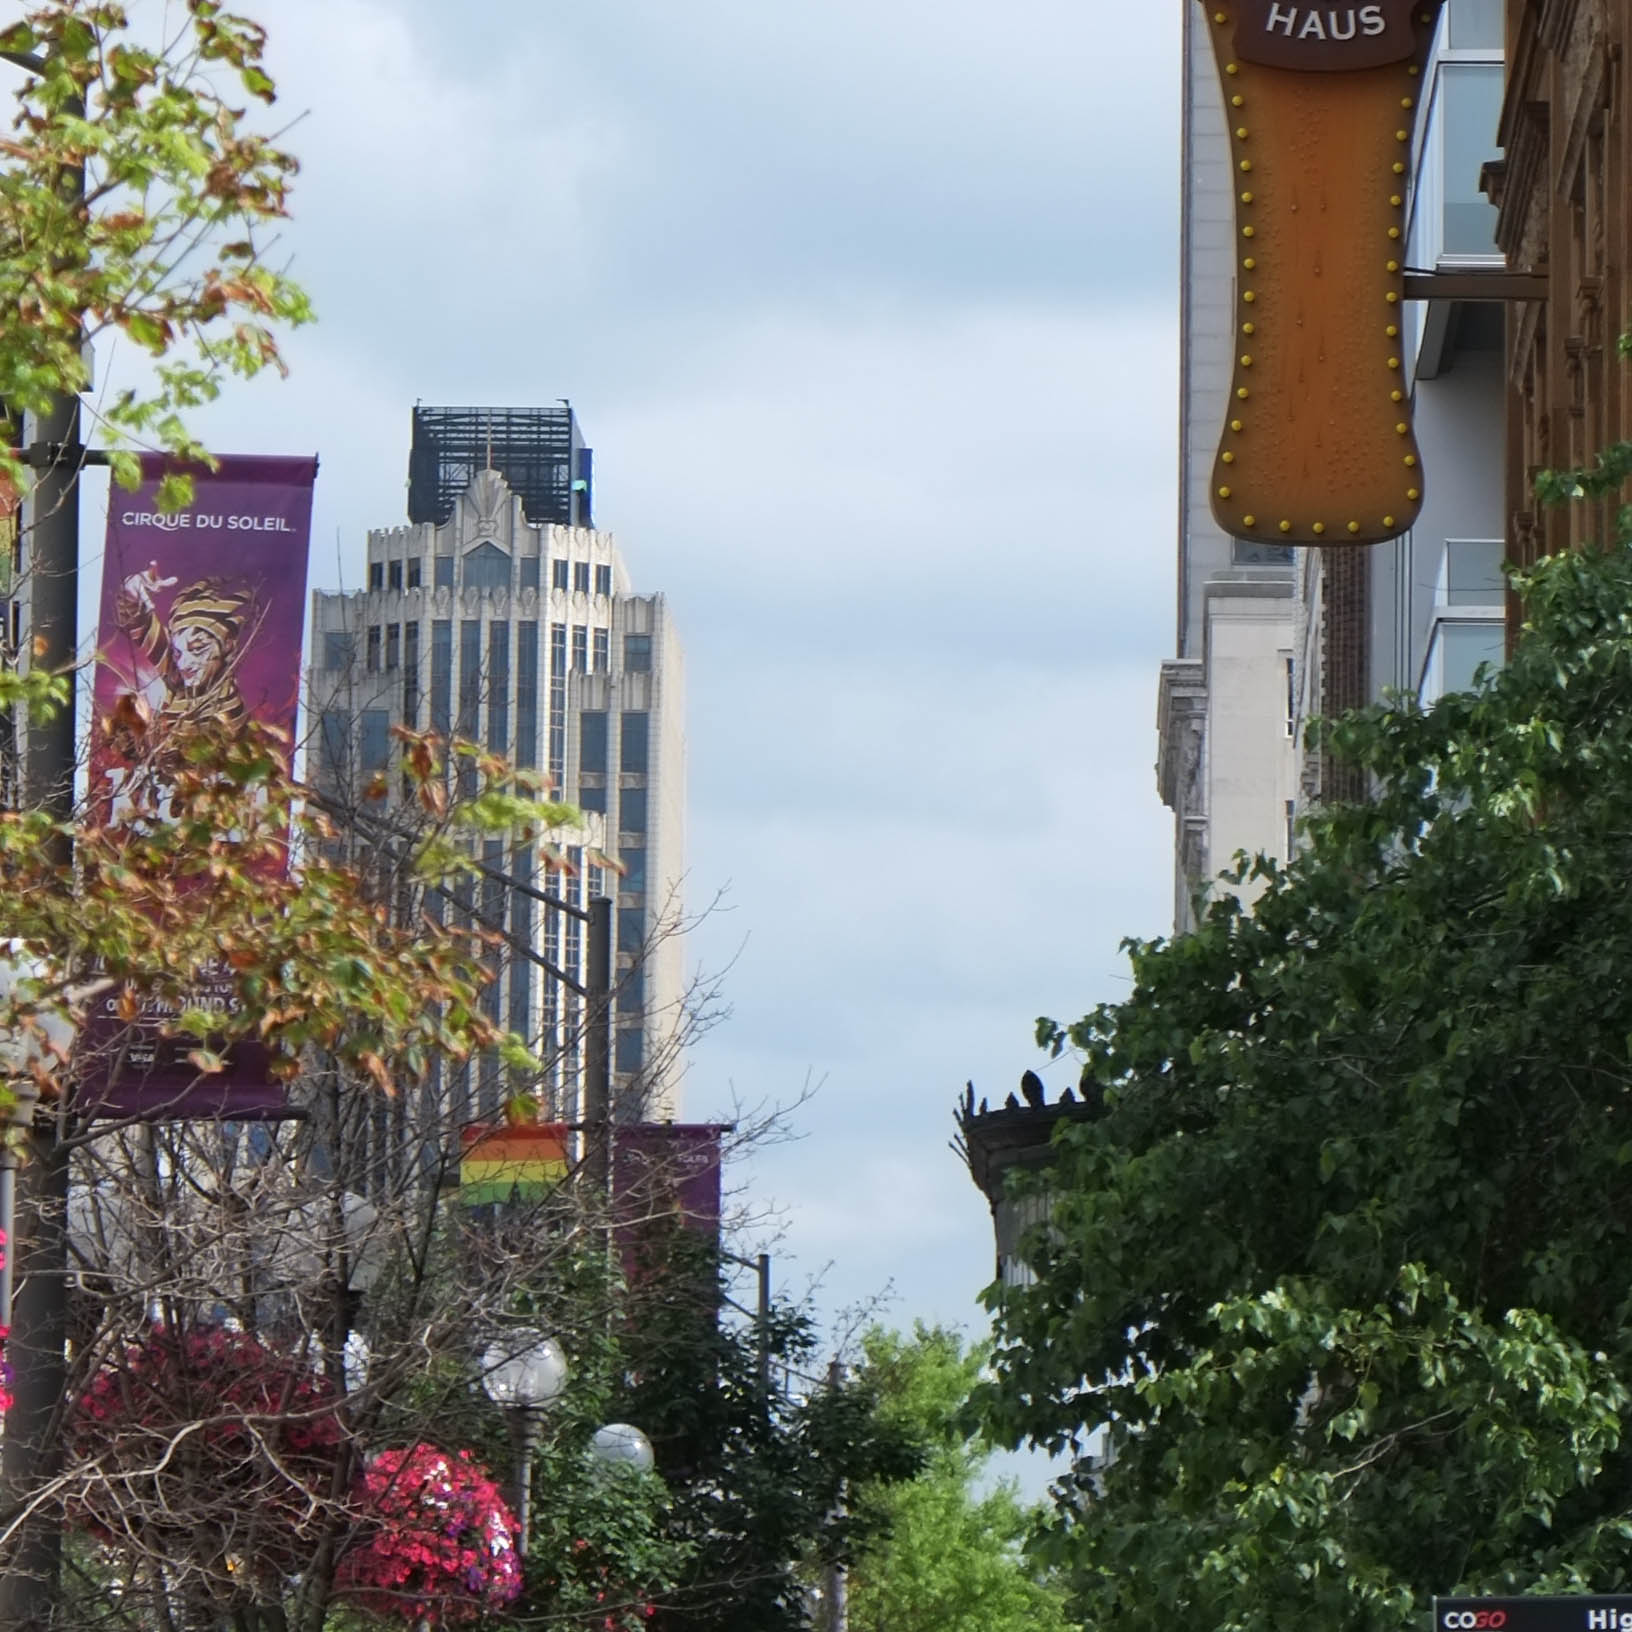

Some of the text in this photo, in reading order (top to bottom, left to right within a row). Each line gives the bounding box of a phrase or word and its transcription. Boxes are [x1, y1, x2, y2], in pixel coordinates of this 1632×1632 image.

[1264, 2, 1387, 42] HAUS
[121, 511, 292, 533] CIRQUE DU SOLEIL
[1443, 1610, 1507, 1630] COGO
